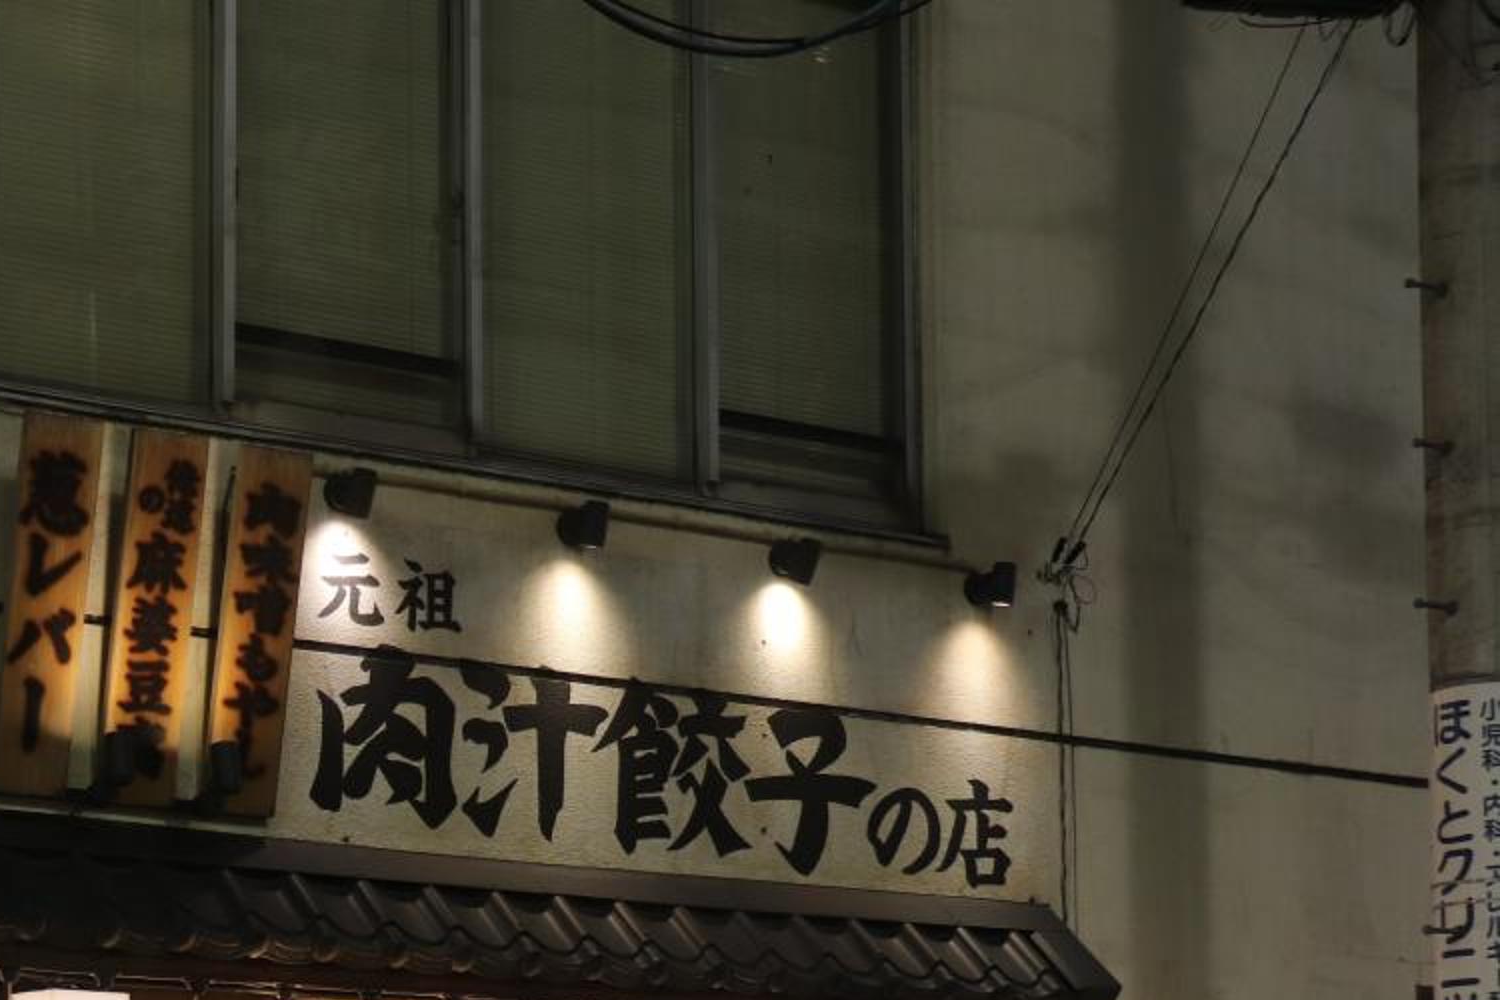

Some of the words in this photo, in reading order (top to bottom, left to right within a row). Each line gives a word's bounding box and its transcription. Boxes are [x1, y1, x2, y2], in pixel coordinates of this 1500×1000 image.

[317, 552, 462, 634] 元祖
[308, 645, 1013, 890] 肉汁餃子の店
